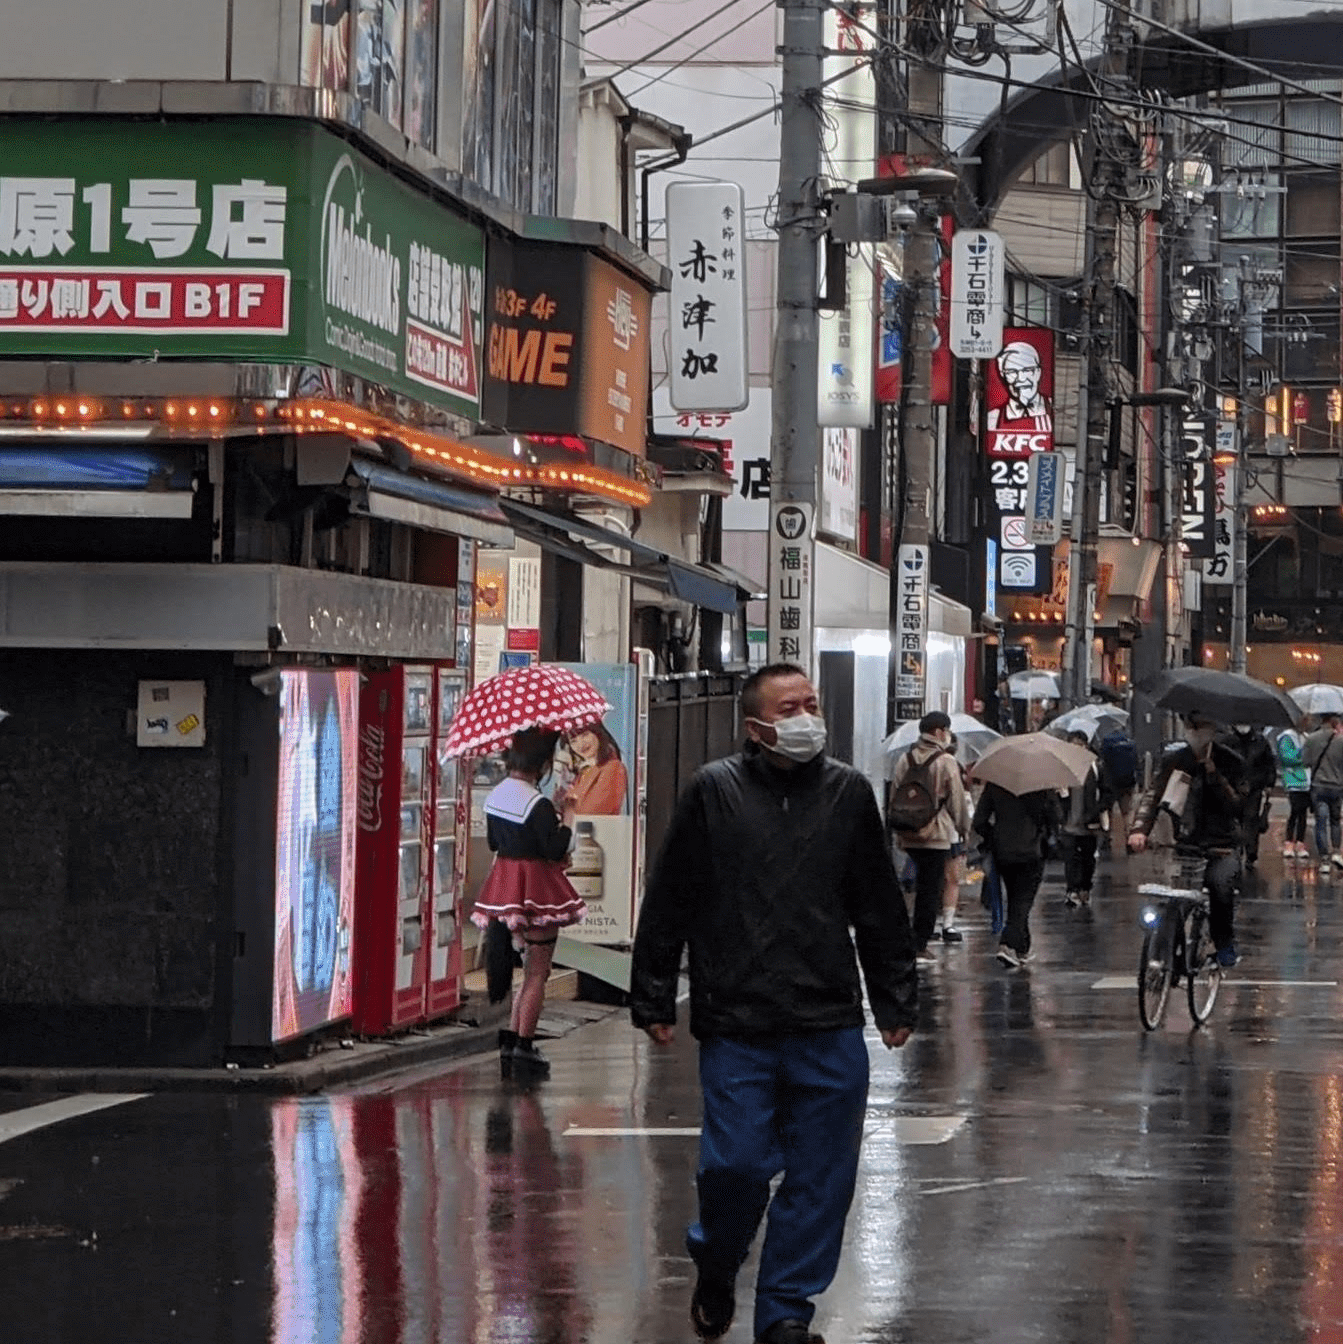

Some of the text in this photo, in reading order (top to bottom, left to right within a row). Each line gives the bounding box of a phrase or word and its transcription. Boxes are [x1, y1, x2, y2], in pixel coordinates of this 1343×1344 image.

[184, 278, 266, 319] B1F
[678, 238, 719, 381] 赤津加
[966, 256, 987, 325] 千石電商
[489, 322, 574, 388] GAME
[992, 435, 1047, 453] KFC
[779, 546, 801, 661] 福山歯科
[902, 575, 922, 651] 千石電商
